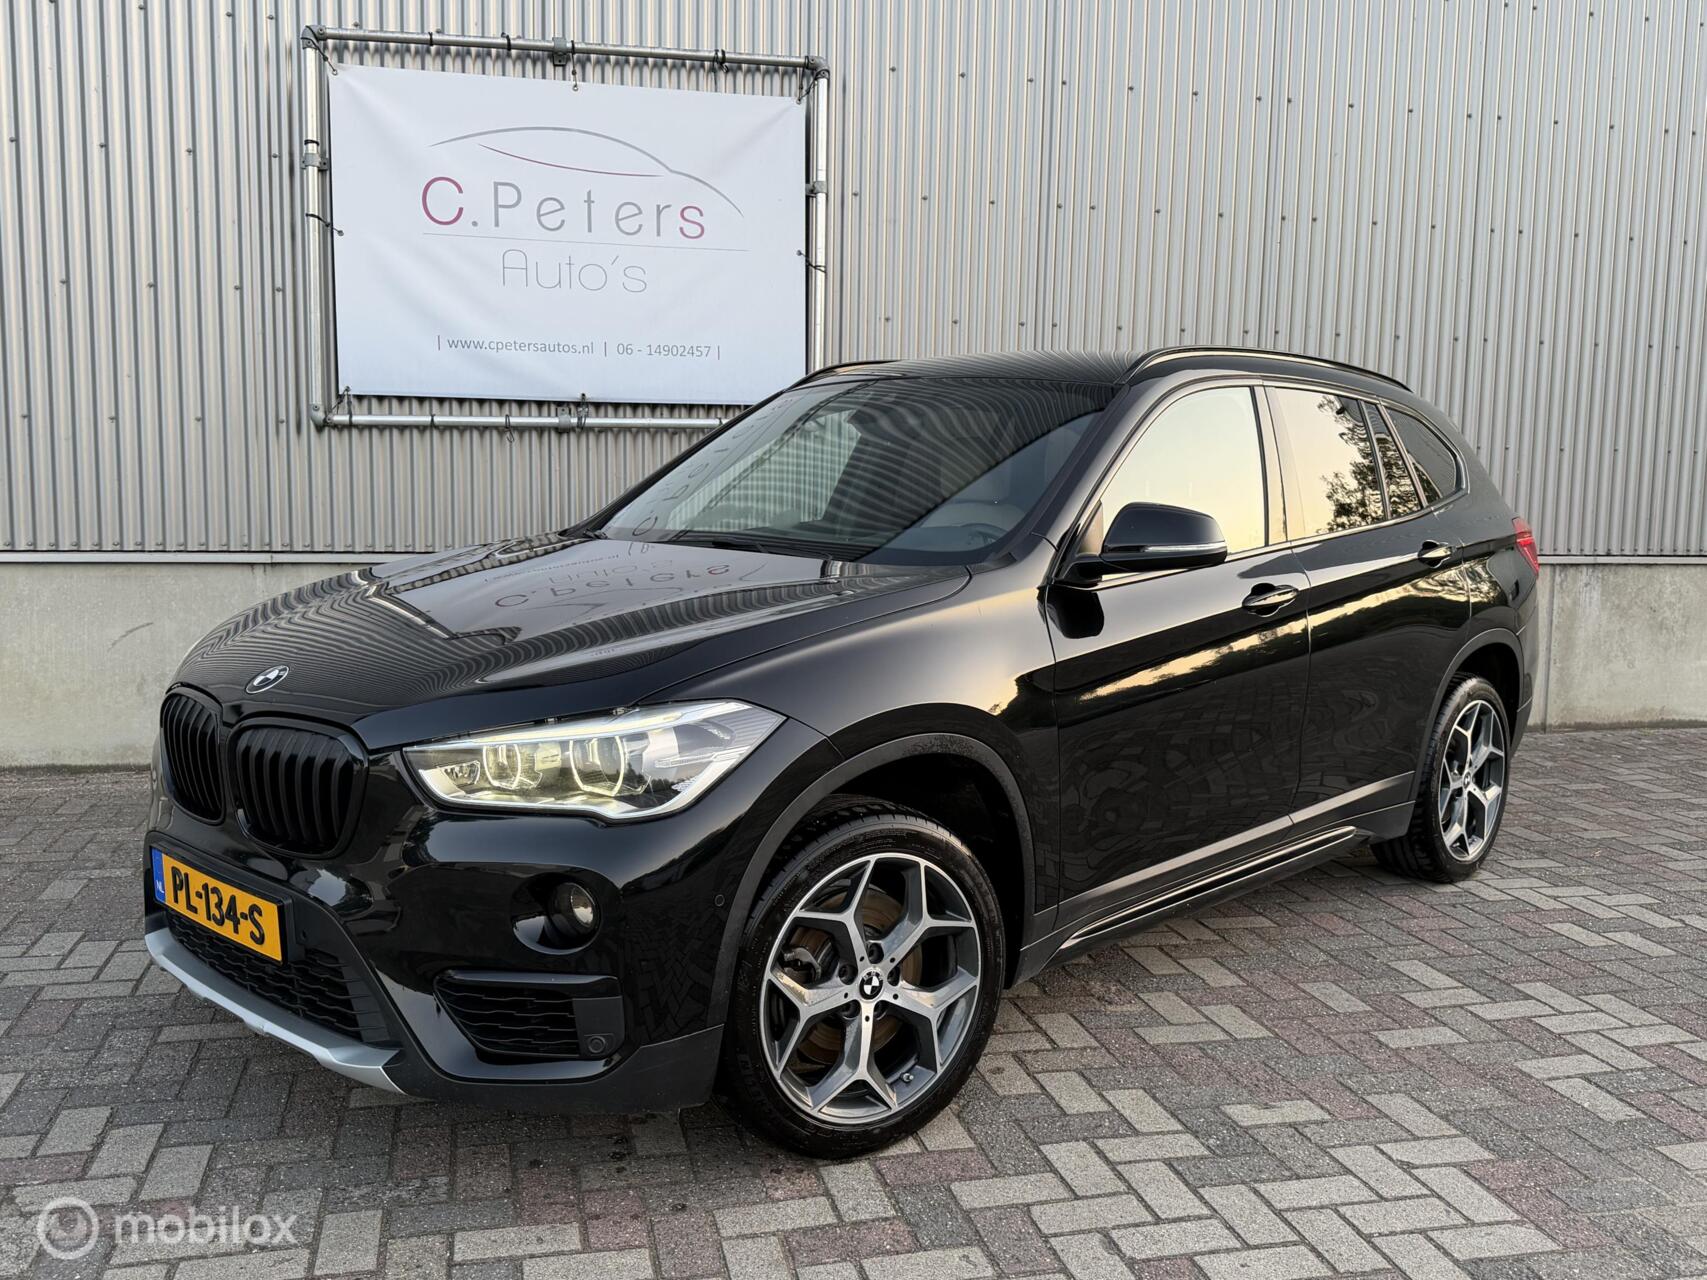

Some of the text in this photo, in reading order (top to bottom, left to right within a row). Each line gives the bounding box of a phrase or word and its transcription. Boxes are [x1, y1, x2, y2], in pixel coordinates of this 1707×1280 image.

[422, 176, 705, 239] C.Peters
[446, 338, 594, 353] www.cpetersautos.nl
[616, 342, 633, 356] 06
[646, 344, 711, 358] 14902457
[156, 879, 165, 894] NL
[171, 866, 265, 945] PL-134-S
